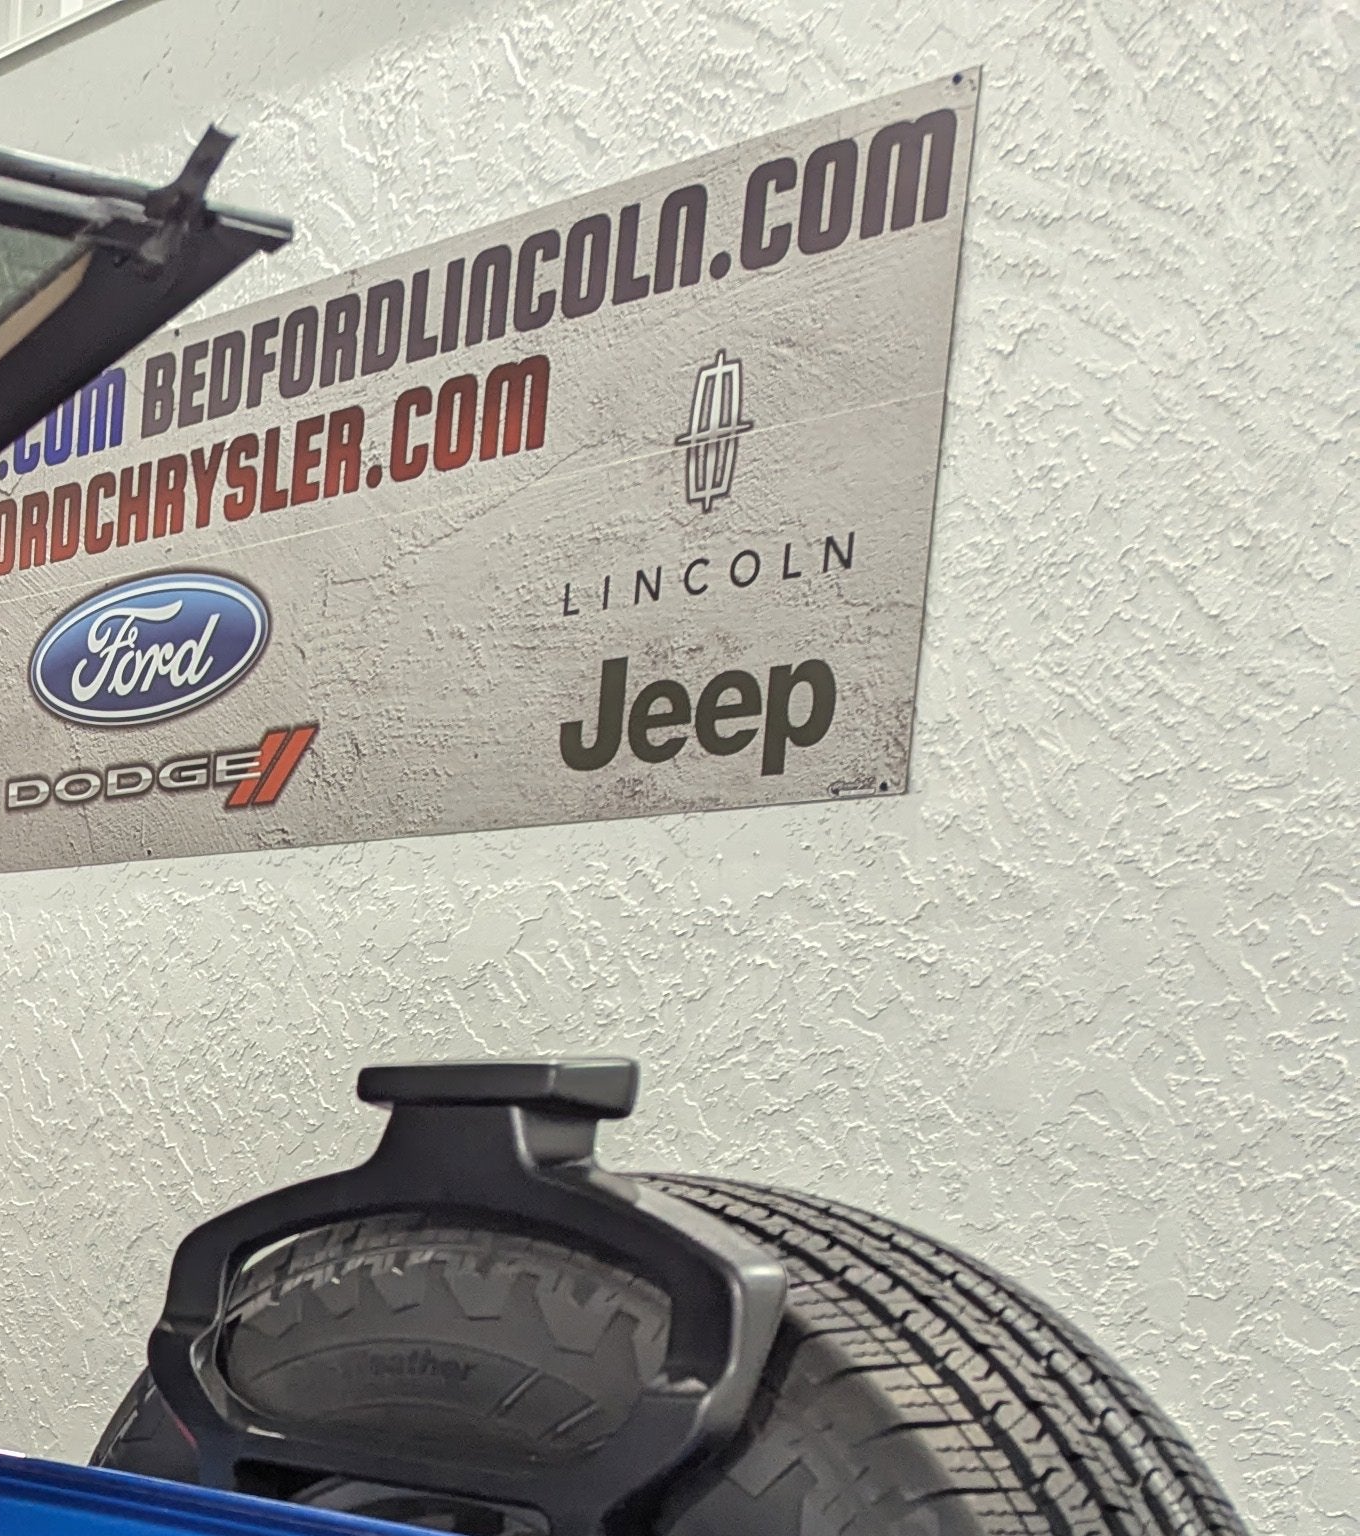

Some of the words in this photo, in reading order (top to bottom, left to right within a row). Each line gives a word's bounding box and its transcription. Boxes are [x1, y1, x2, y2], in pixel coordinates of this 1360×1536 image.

[140, 107, 958, 440] BEDFORDLINCOLN.COM
[563, 531, 855, 616] LINCOLN
[71, 599, 221, 702] Ford
[560, 656, 837, 777] Jeep
[7, 750, 263, 809] DODGE
